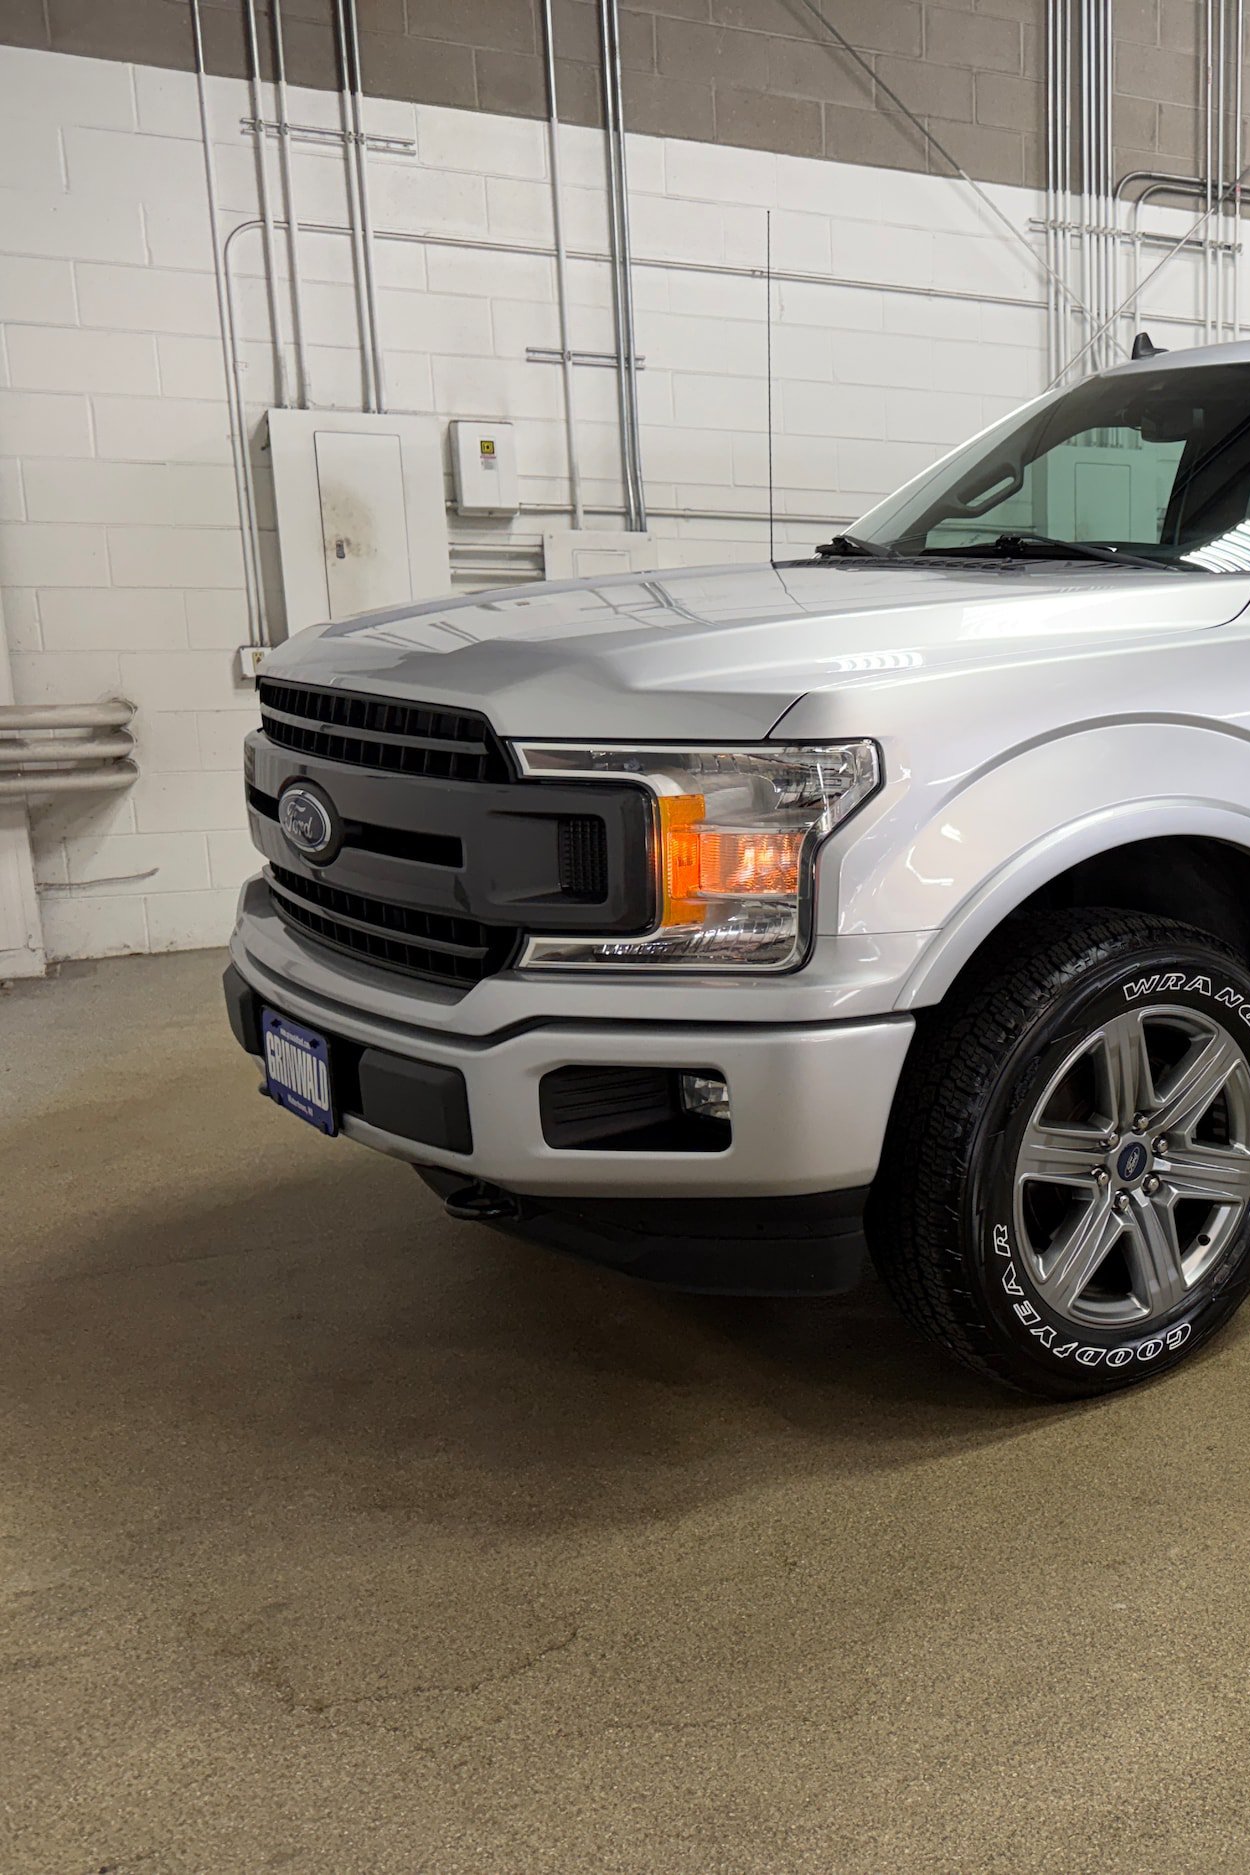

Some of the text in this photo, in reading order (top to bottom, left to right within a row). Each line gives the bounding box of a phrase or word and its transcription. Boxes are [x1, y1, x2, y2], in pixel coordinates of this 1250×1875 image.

[285, 801, 313, 839] Ford
[266, 1030, 329, 1112] GRINWALD
[993, 1223, 1192, 1368] GOODYEAR
